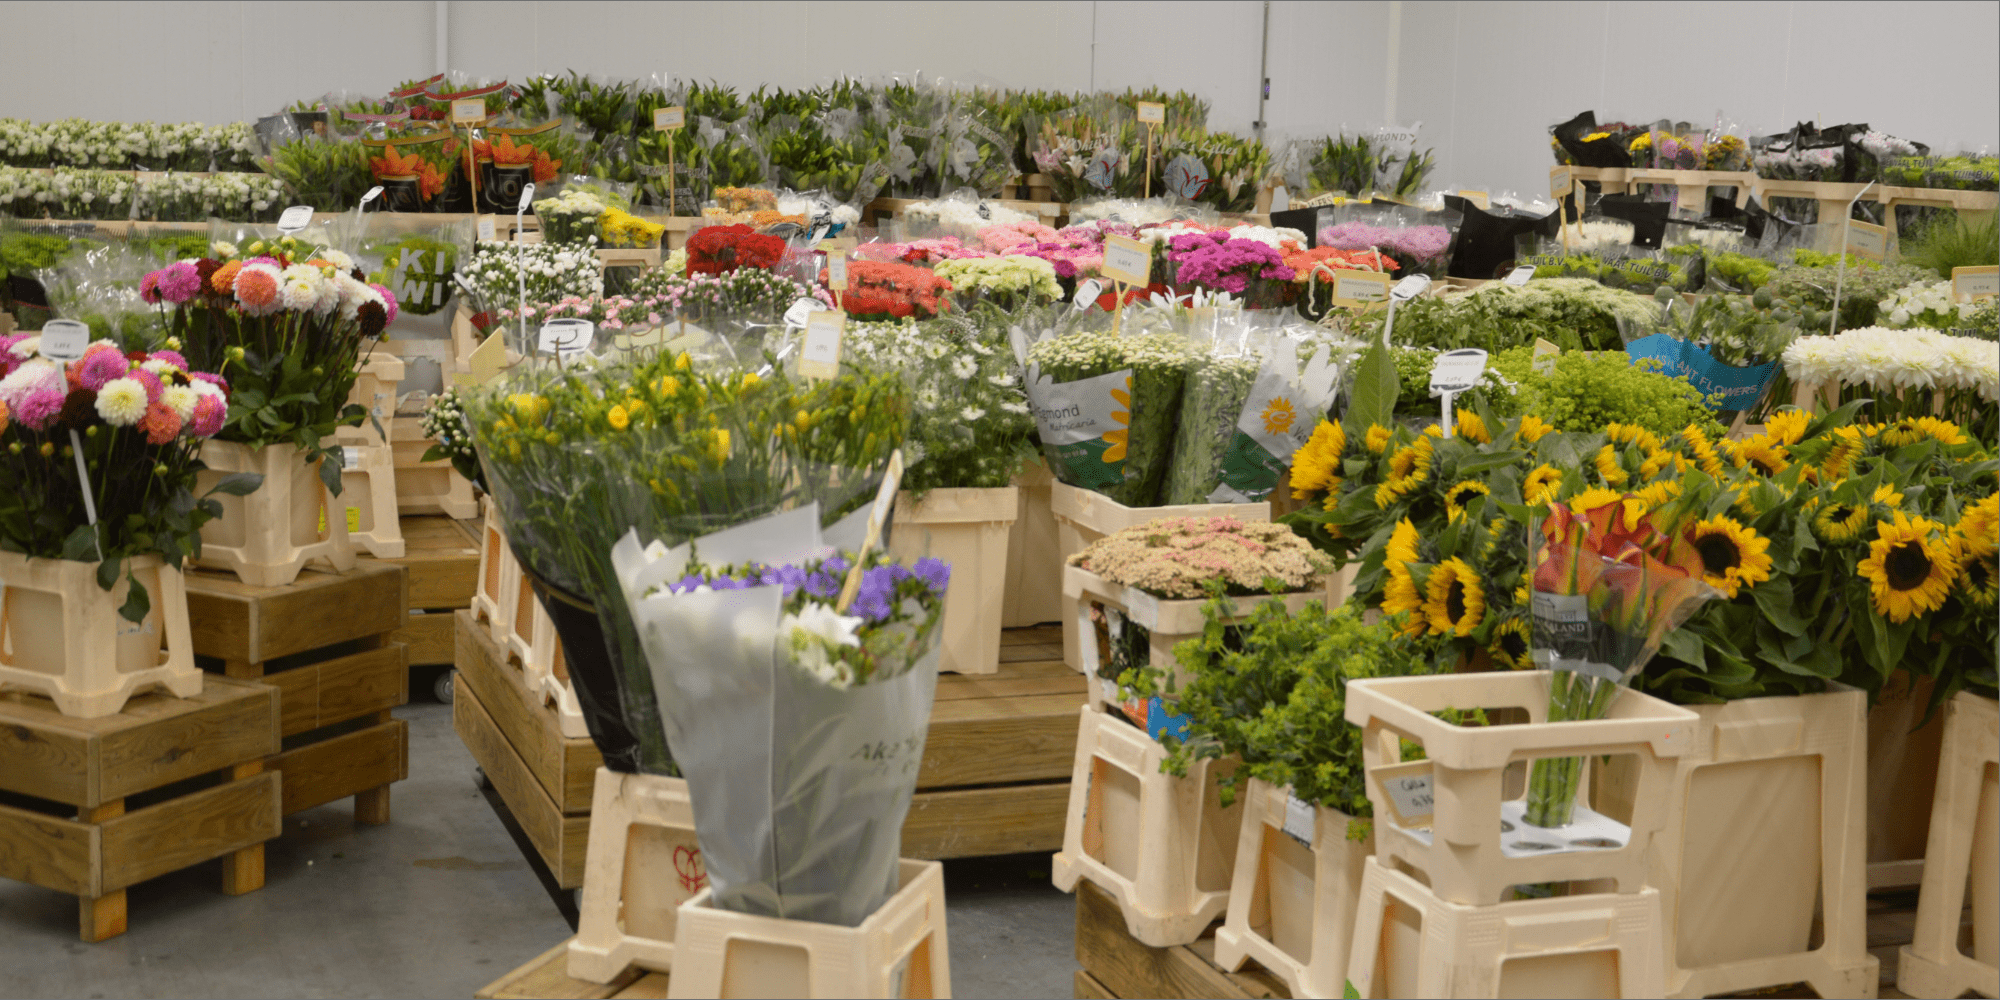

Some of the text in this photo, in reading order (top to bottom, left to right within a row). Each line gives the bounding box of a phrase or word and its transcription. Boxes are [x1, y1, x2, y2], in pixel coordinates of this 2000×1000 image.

[399, 247, 445, 275] KI
[1528, 257, 1547, 267] TUIL
[1629, 262, 1652, 276] TUIL
[397, 280, 443, 306] WI
[1699, 377, 1758, 398] FLOWERS
